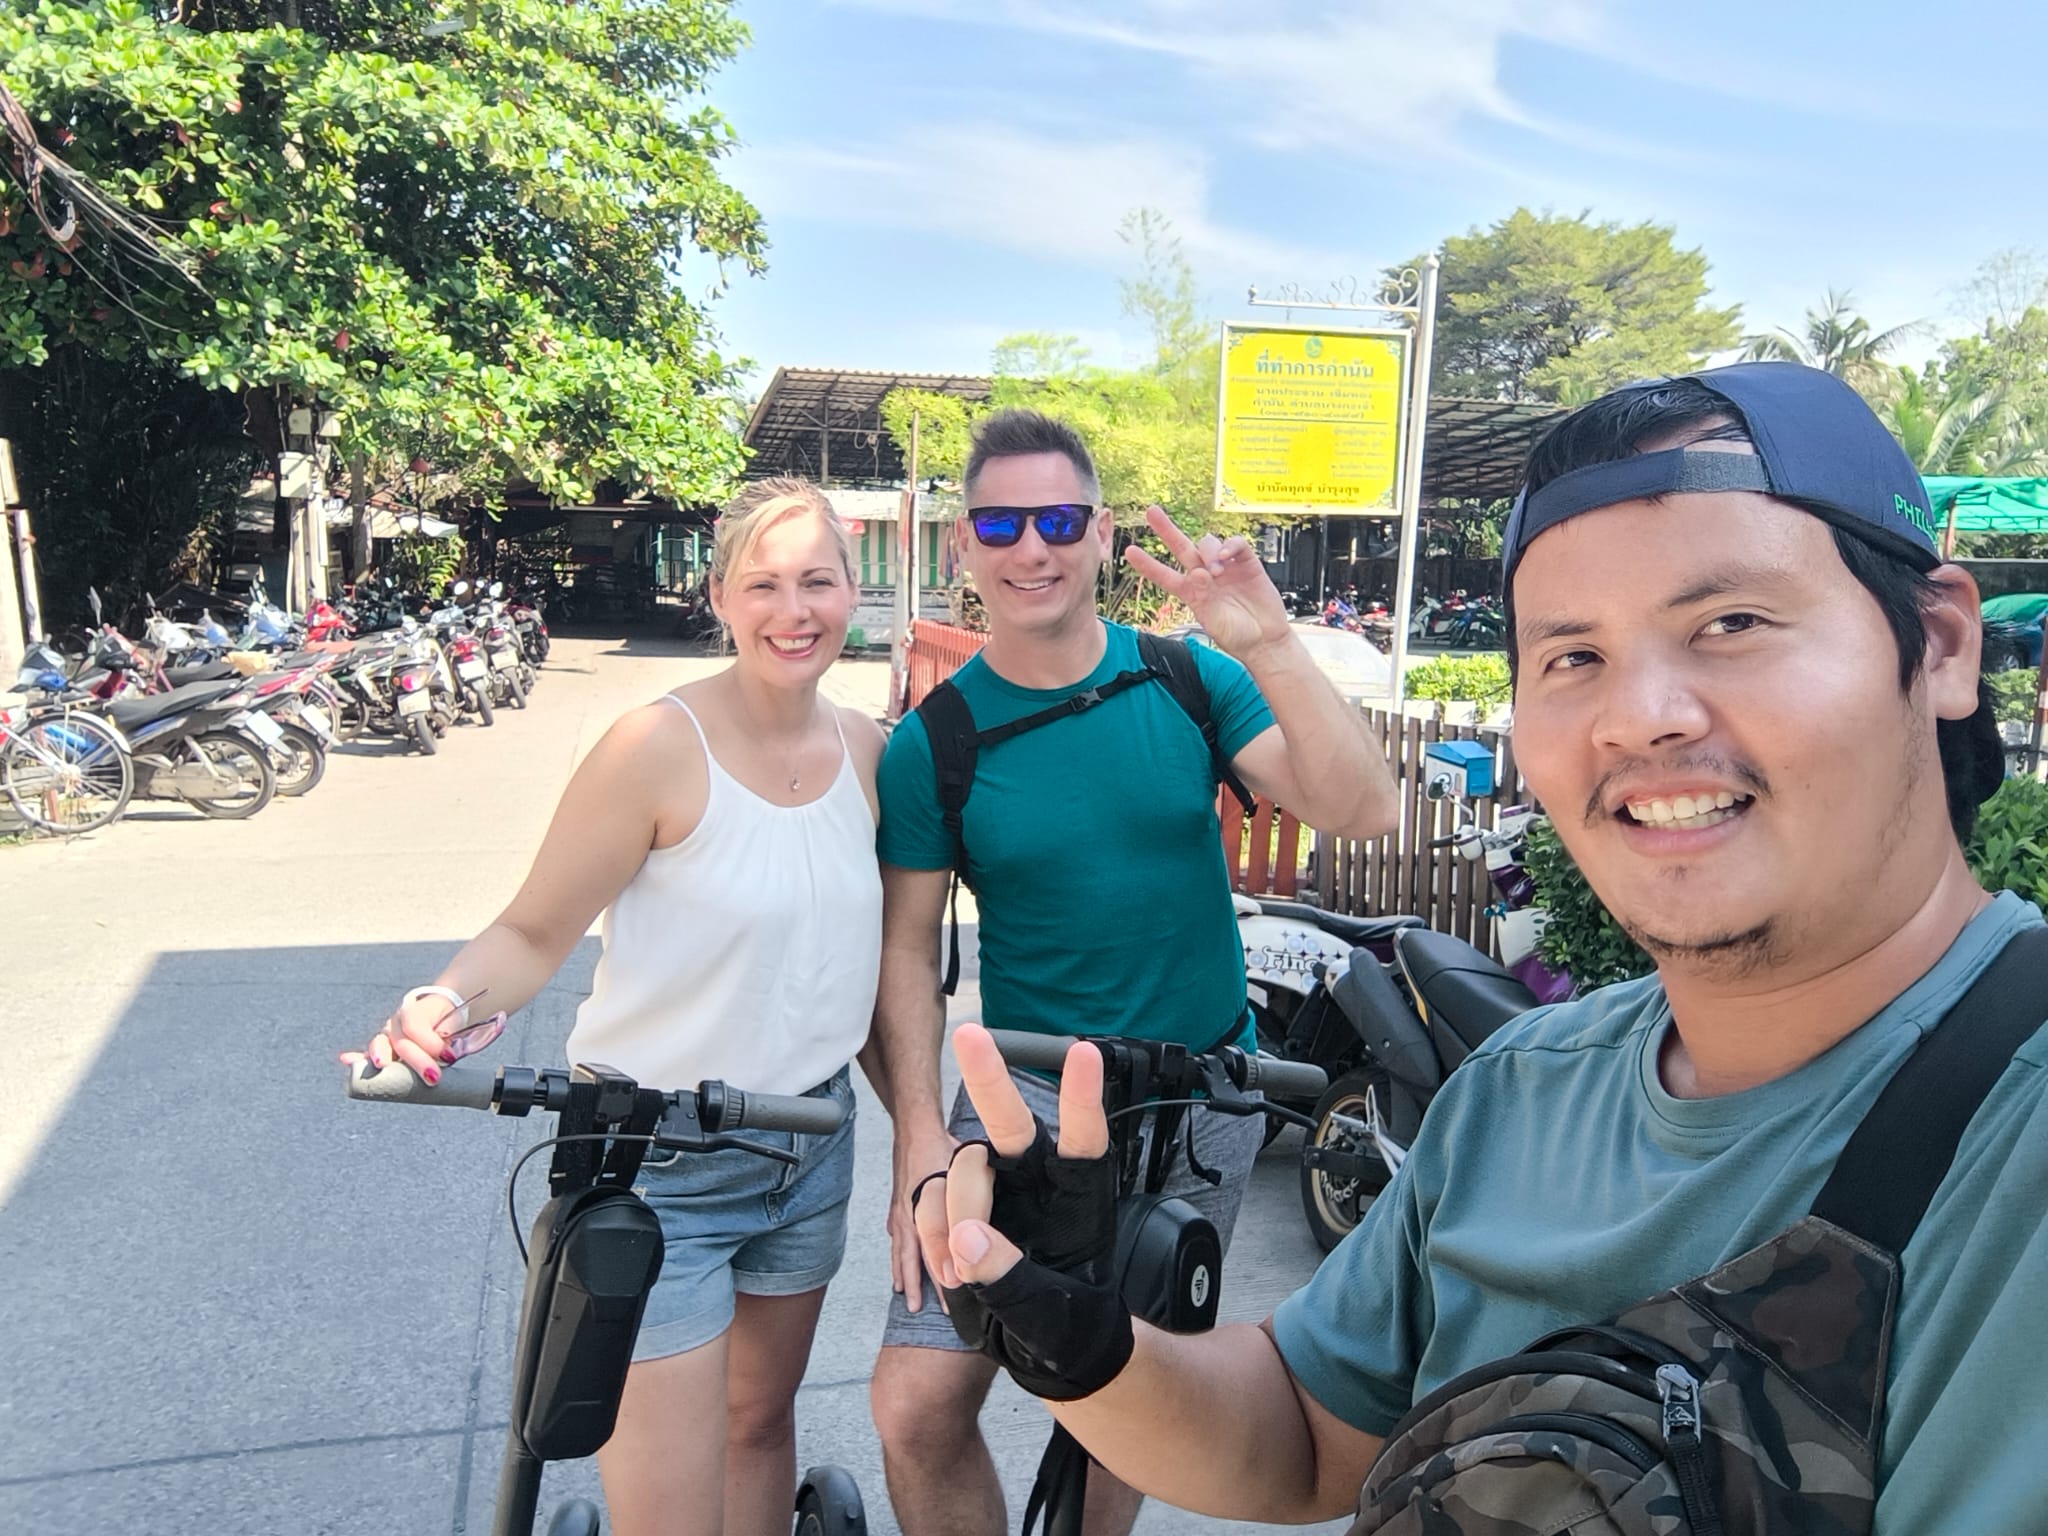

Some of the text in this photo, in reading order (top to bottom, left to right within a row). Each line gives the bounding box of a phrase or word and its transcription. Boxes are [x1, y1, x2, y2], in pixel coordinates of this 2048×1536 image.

[1256, 349, 1374, 378] ที่ทำการกำนัน
